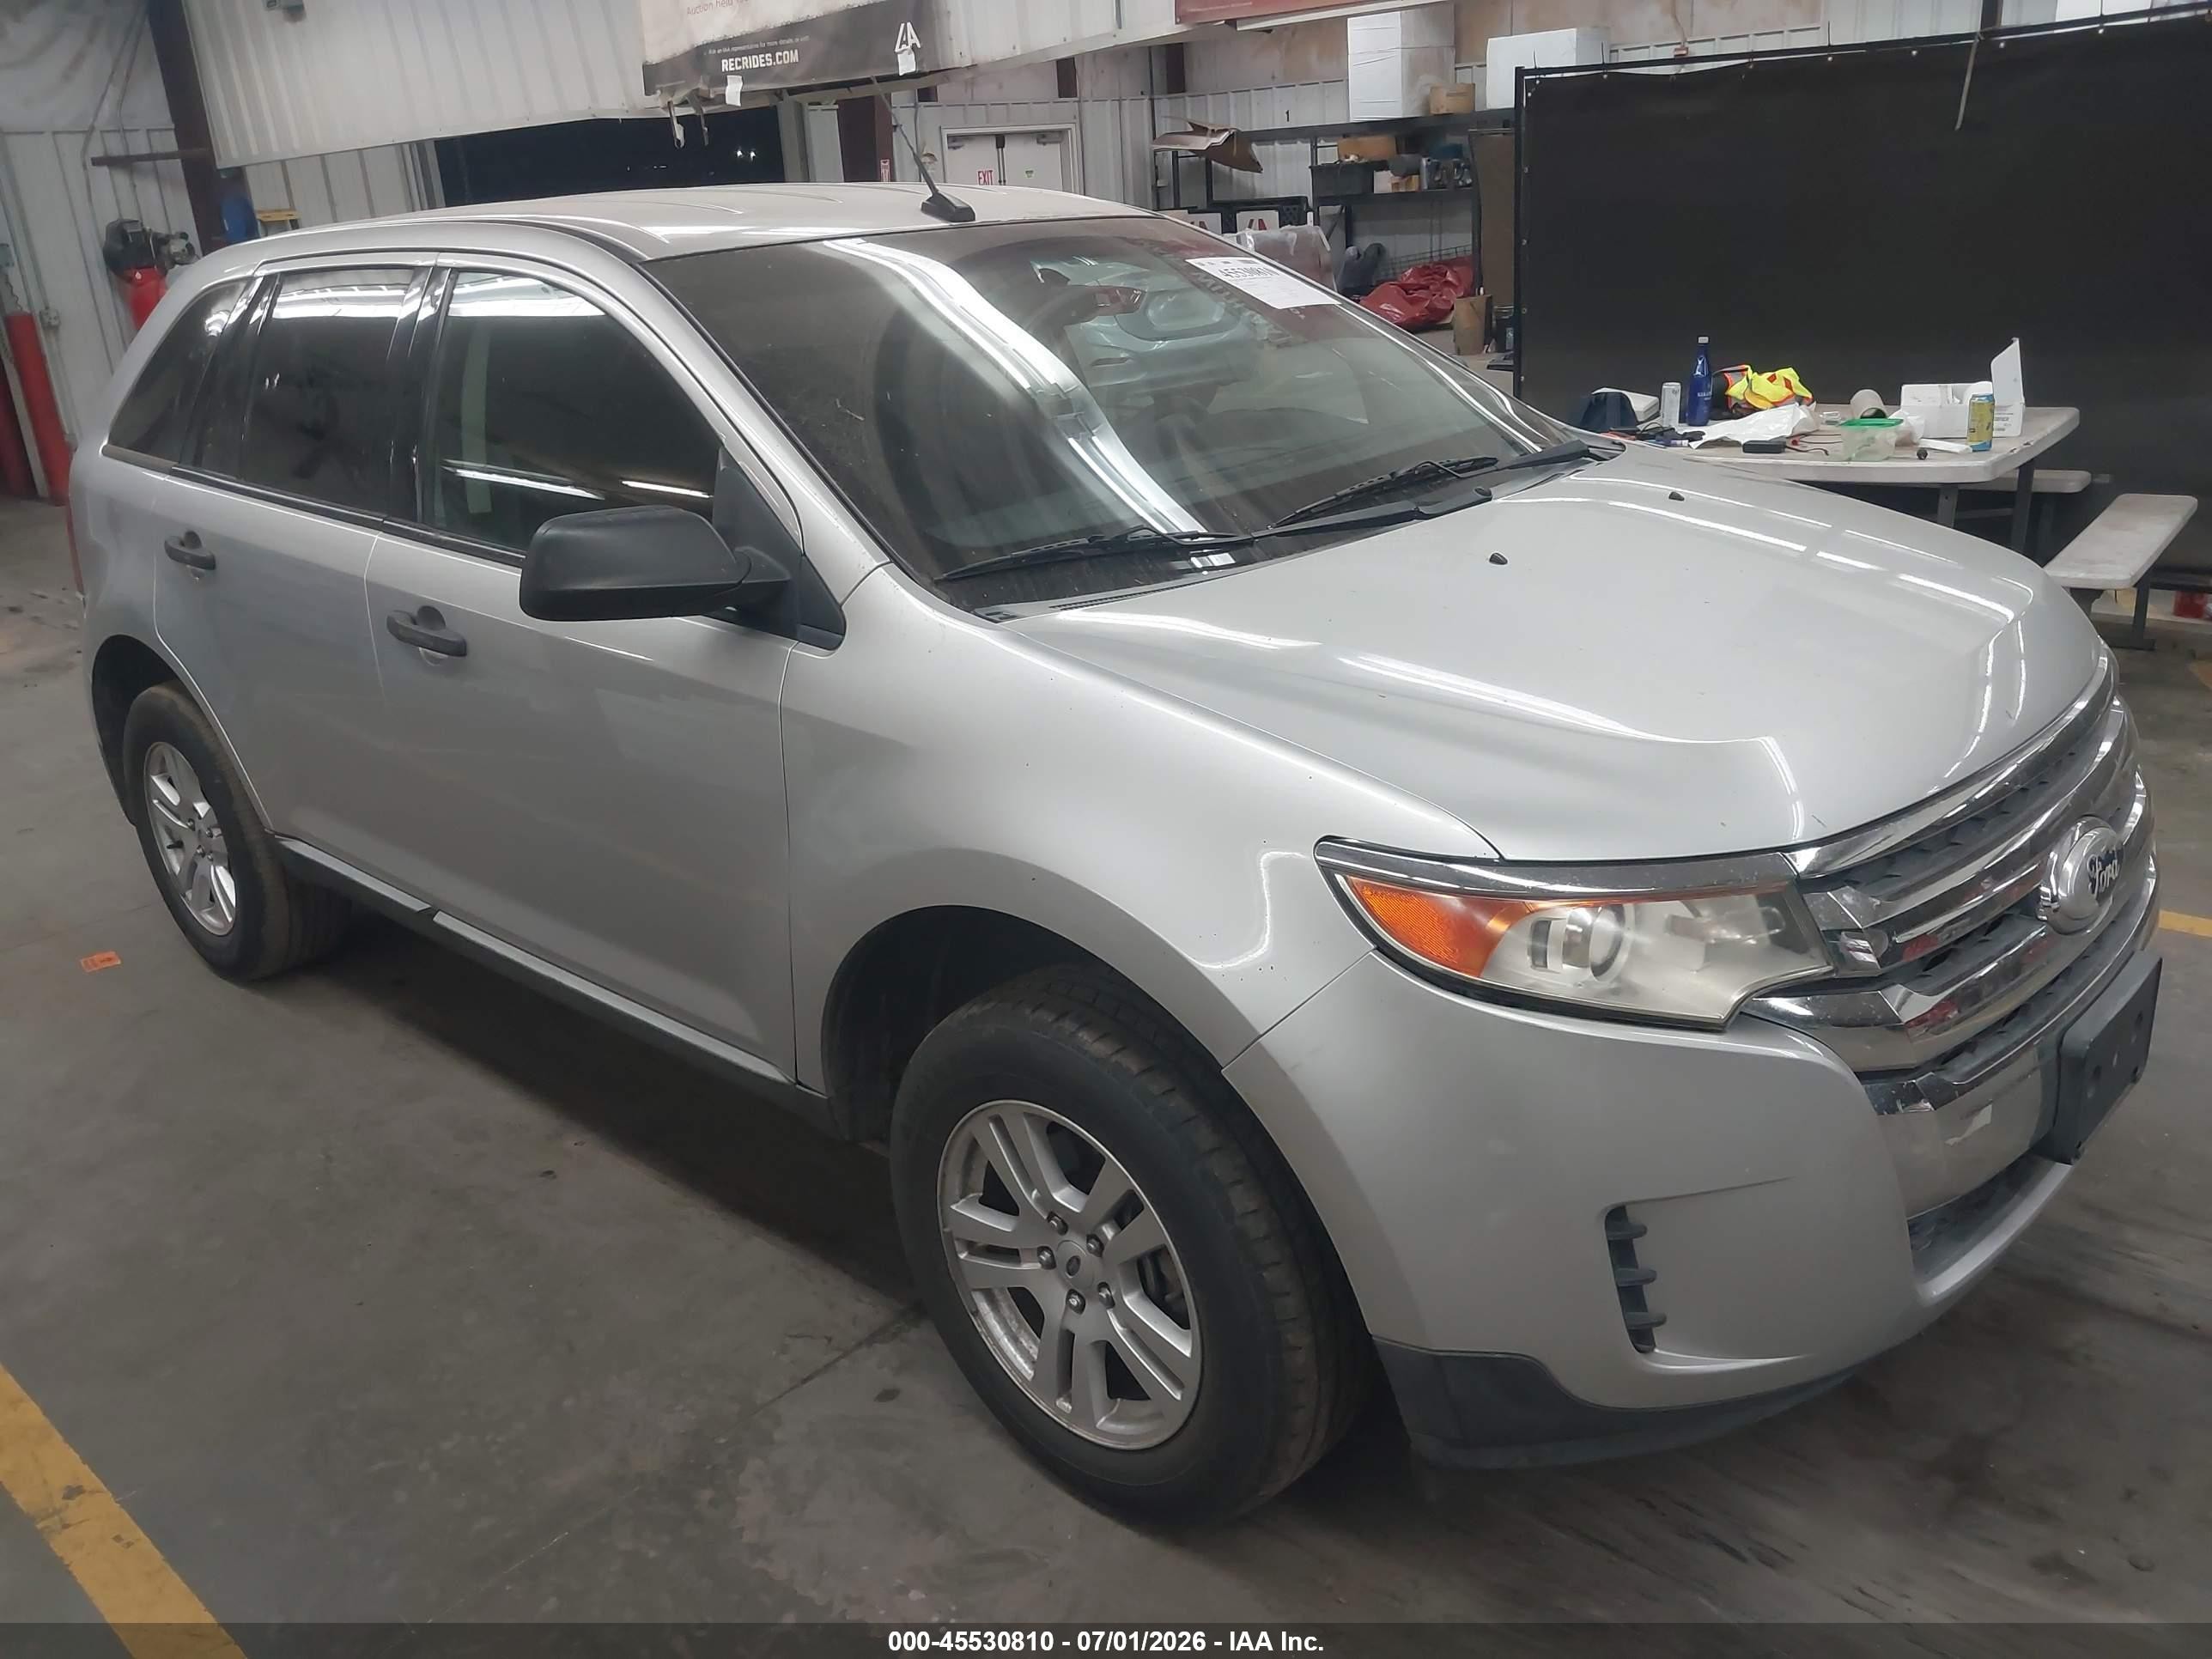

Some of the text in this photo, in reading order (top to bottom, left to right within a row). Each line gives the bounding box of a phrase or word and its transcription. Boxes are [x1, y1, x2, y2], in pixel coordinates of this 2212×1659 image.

[687, 3, 714, 15] Auction
[721, 49, 799, 72] RECRIDES.COM
[978, 170, 994, 185] EXIT
[2087, 848, 2118, 900] Ford
